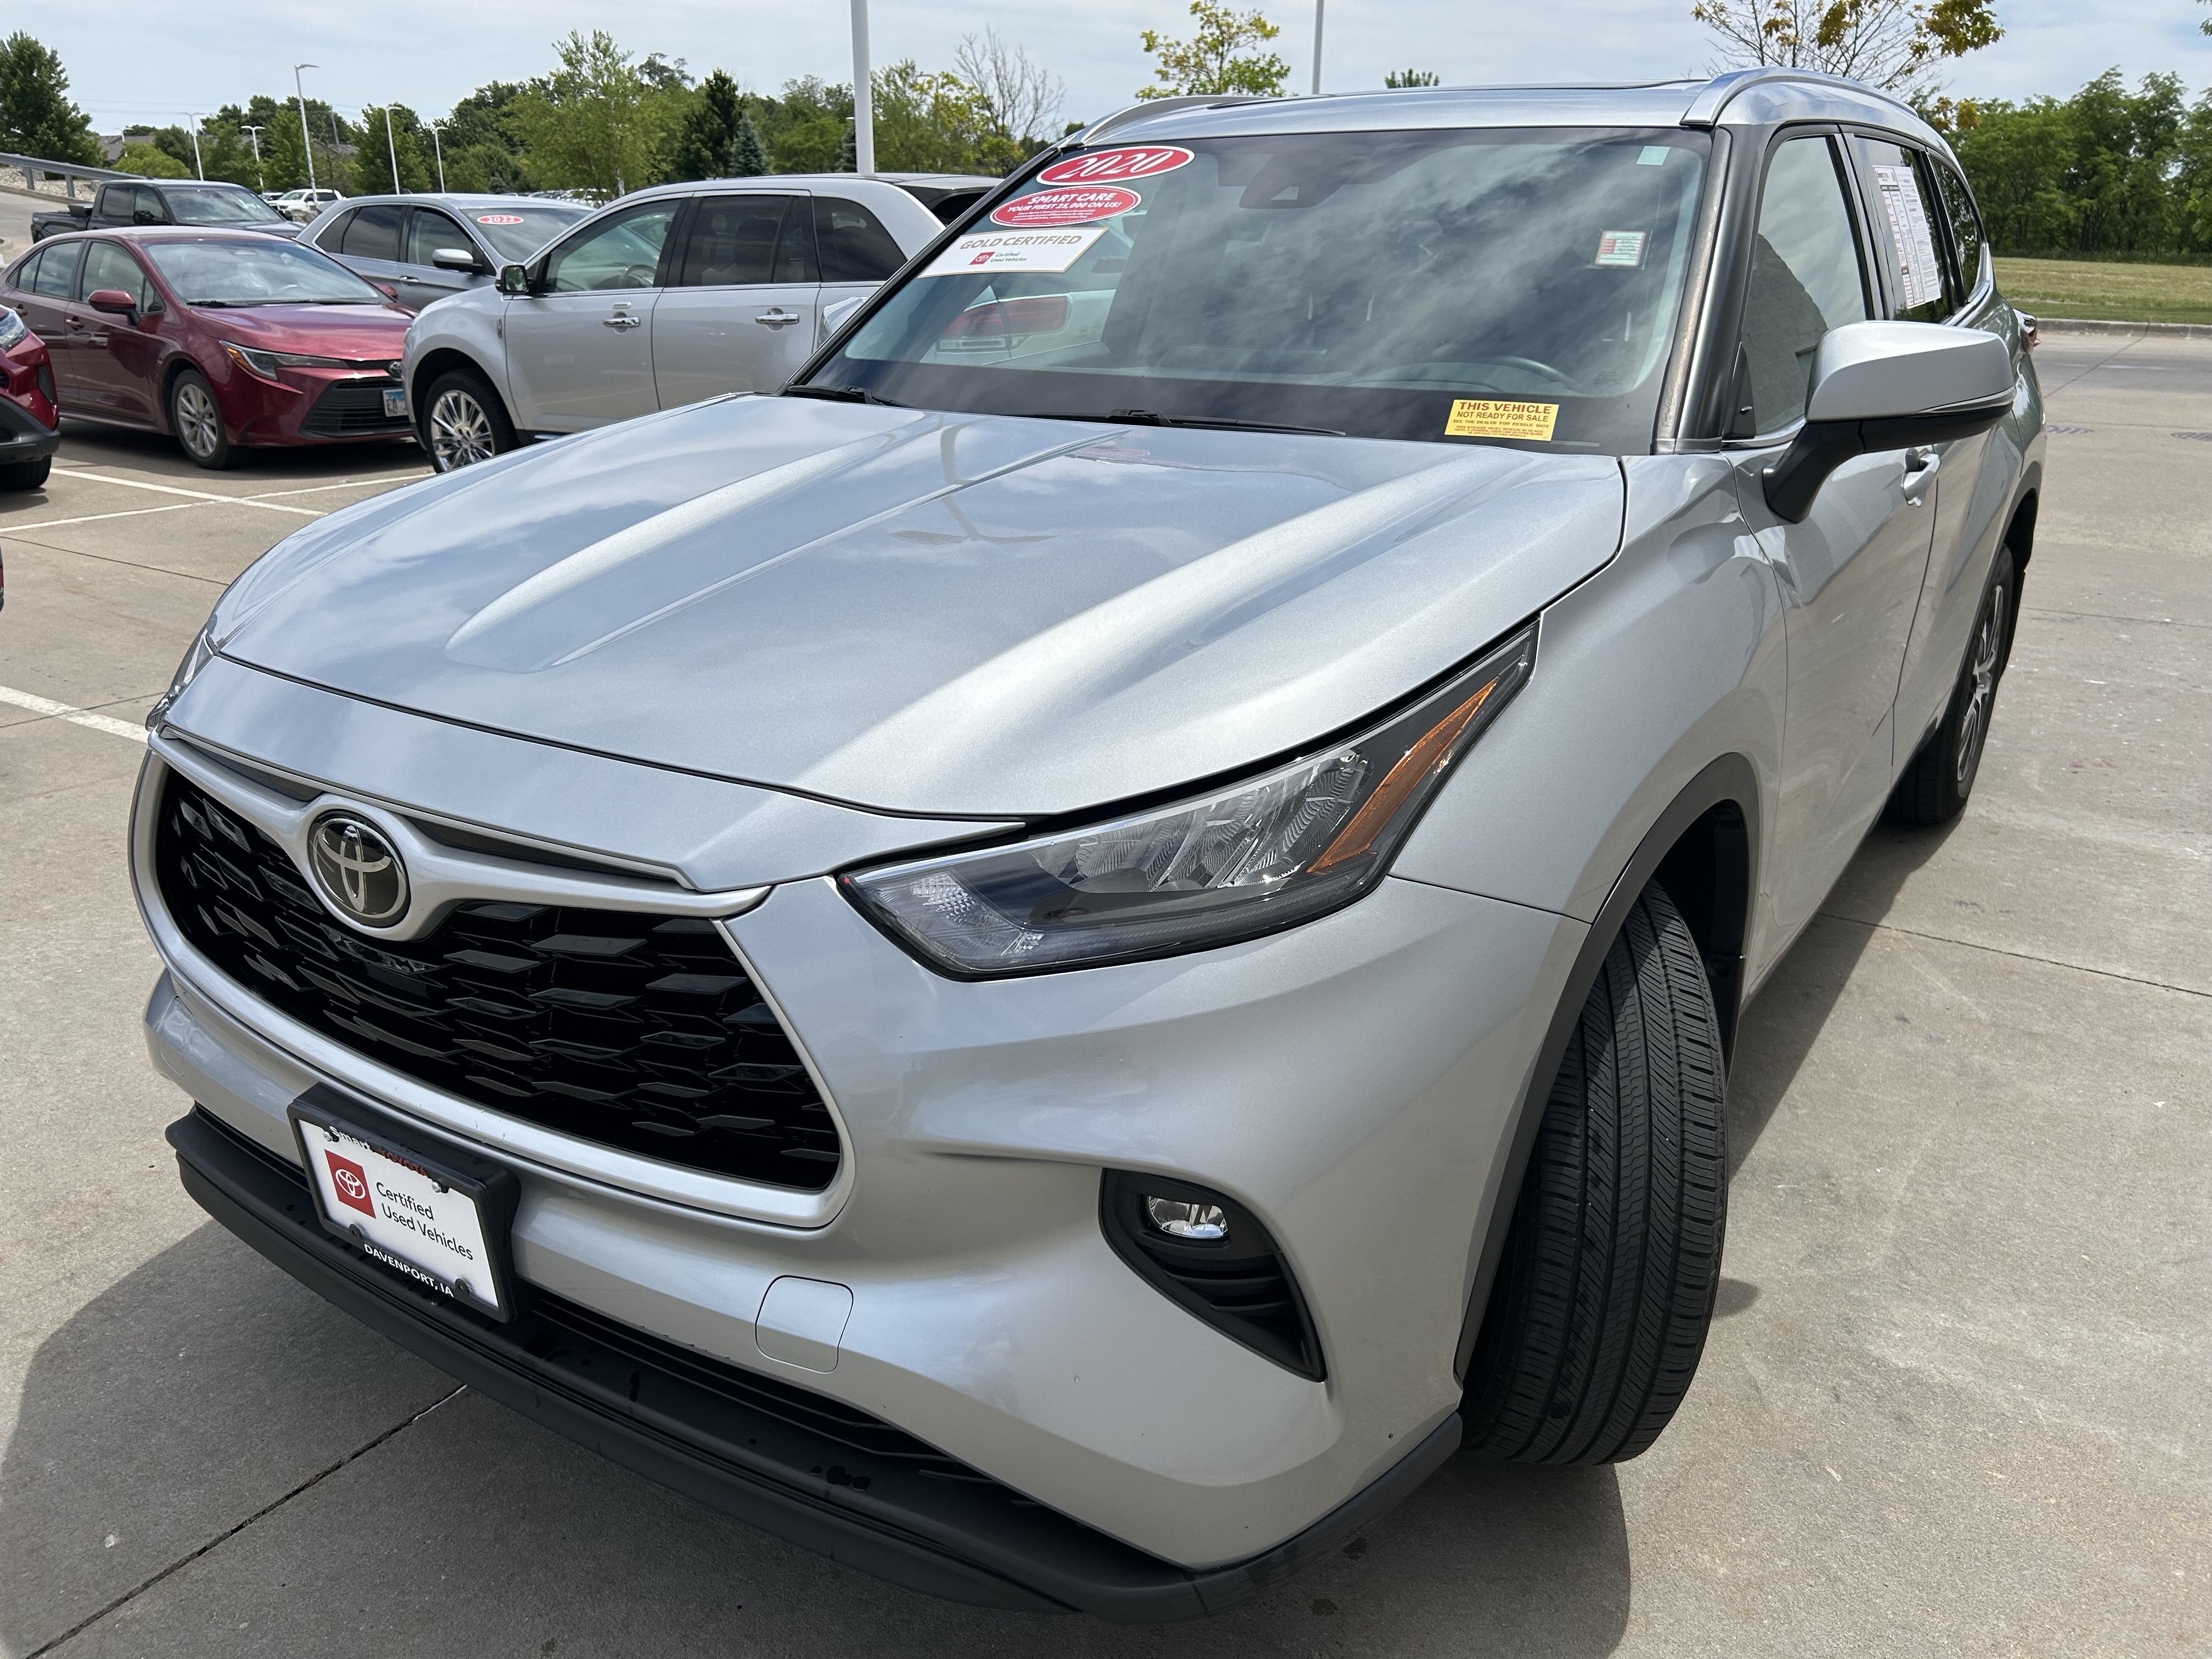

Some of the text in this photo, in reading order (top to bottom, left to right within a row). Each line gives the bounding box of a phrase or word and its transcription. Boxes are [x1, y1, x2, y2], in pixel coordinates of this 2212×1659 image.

[1051, 151, 1174, 180] 2020
[1028, 193, 1118, 205] SMART CARE
[960, 235, 1082, 249] GOLD CERTIFIED
[1460, 402, 1552, 414] THIS VEHICLE
[1526, 414, 1549, 422] SALE
[329, 1126, 371, 1149] Smart
[376, 1182, 434, 1221] Certified
[381, 1203, 473, 1261] Used Vehicles
[364, 1243, 454, 1298] DAVENPORT, IA
